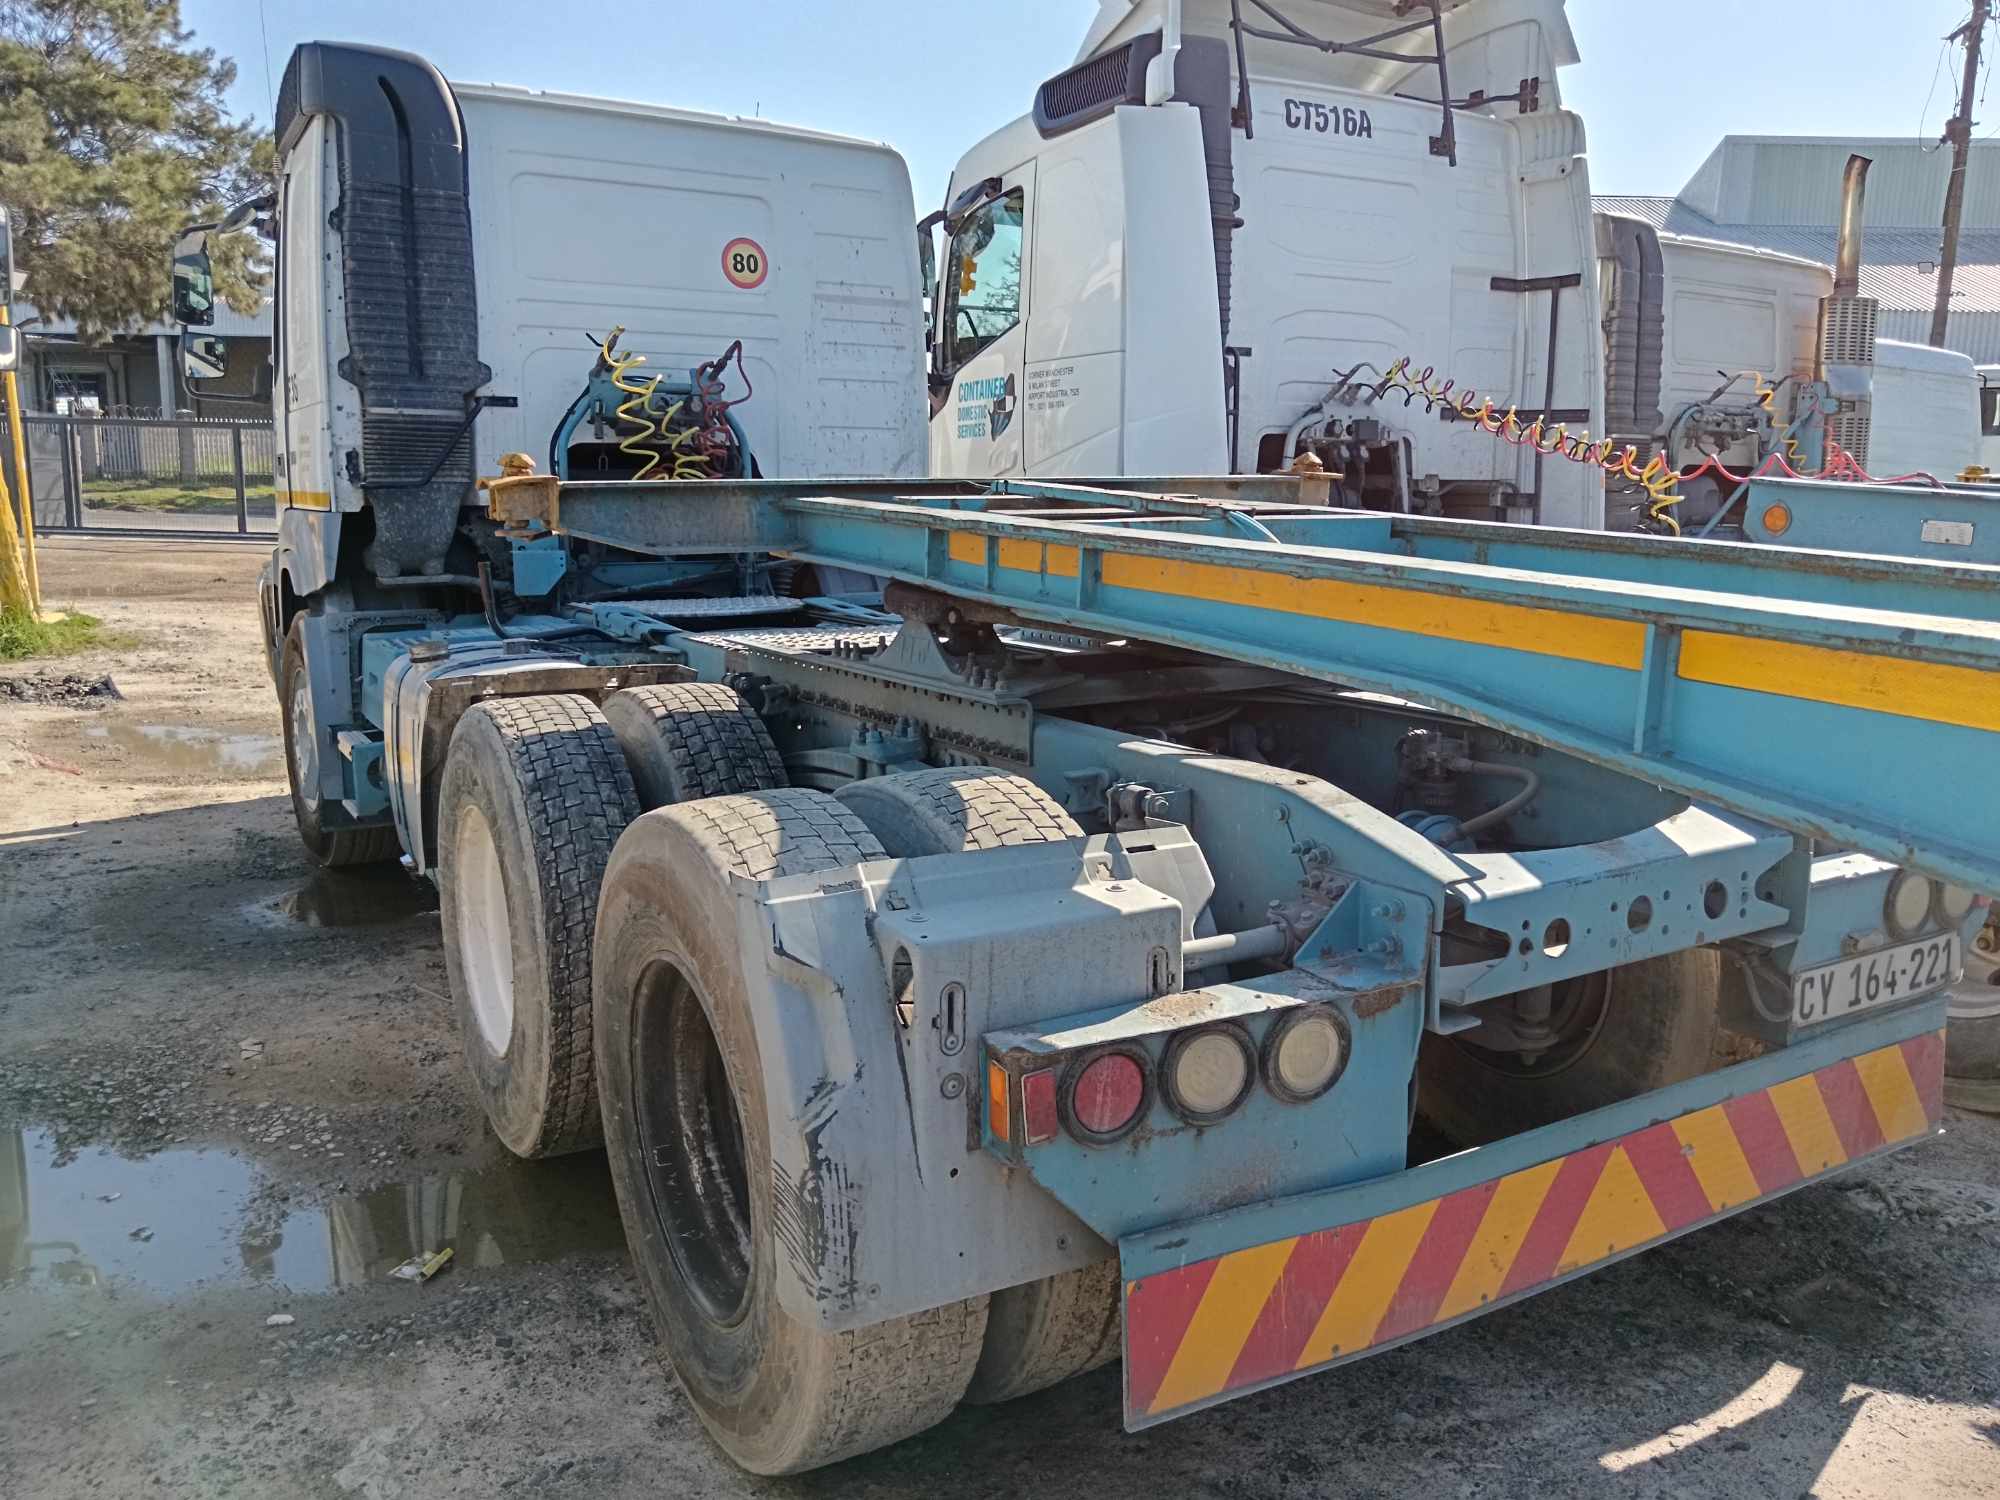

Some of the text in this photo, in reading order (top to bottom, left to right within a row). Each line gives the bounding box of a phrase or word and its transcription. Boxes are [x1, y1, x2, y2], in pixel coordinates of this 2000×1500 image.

[1284, 98, 1372, 139] CT516A
[732, 252, 759, 274] 80
[958, 377, 1006, 403] CONTAINER
[958, 404, 987, 422] DOMESTIC
[958, 422, 986, 439] SERVICES
[1799, 938, 1952, 1020] CY 164-221
